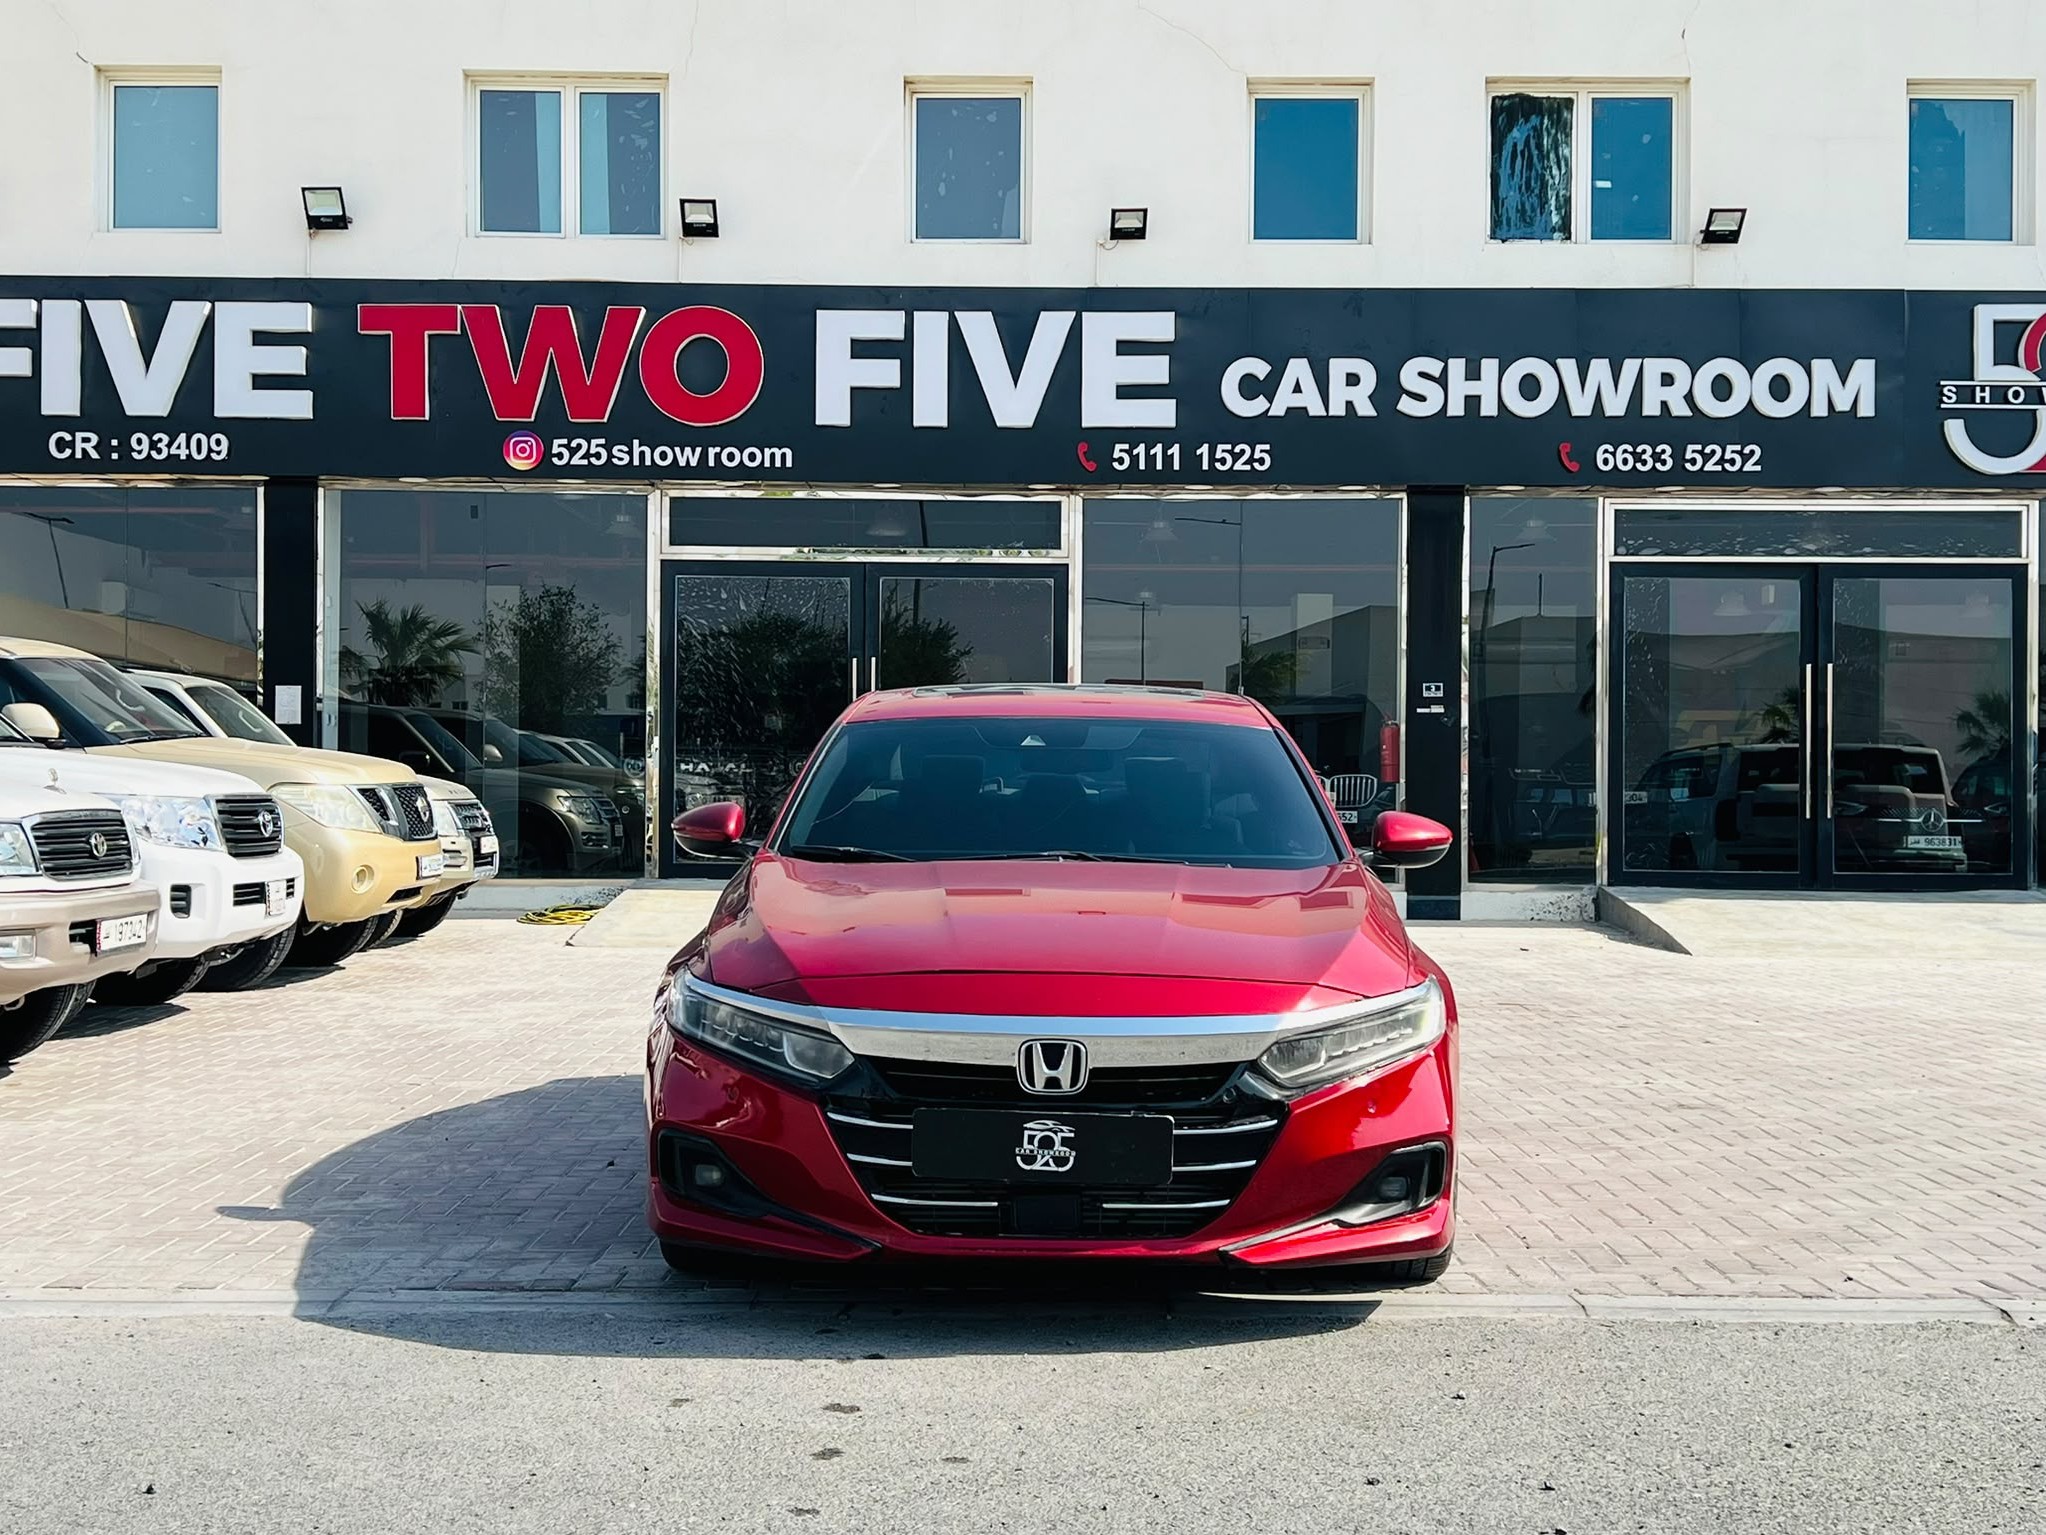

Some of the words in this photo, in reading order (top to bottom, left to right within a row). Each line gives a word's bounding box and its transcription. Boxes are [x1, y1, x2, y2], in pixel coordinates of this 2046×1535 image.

[357, 303, 765, 427] TWO
[815, 309, 1177, 428] FIVE
[1220, 356, 1378, 418] CAR
[1396, 356, 1876, 418] SHOWROOM
[1942, 385, 2046, 404] SHO
[48, 431, 100, 459] CR
[130, 432, 229, 461] 93409
[1112, 443, 1180, 471] 5111
[1196, 443, 1271, 471] 1525
[1596, 443, 1673, 472] 6633
[1684, 444, 1762, 472] 5252
